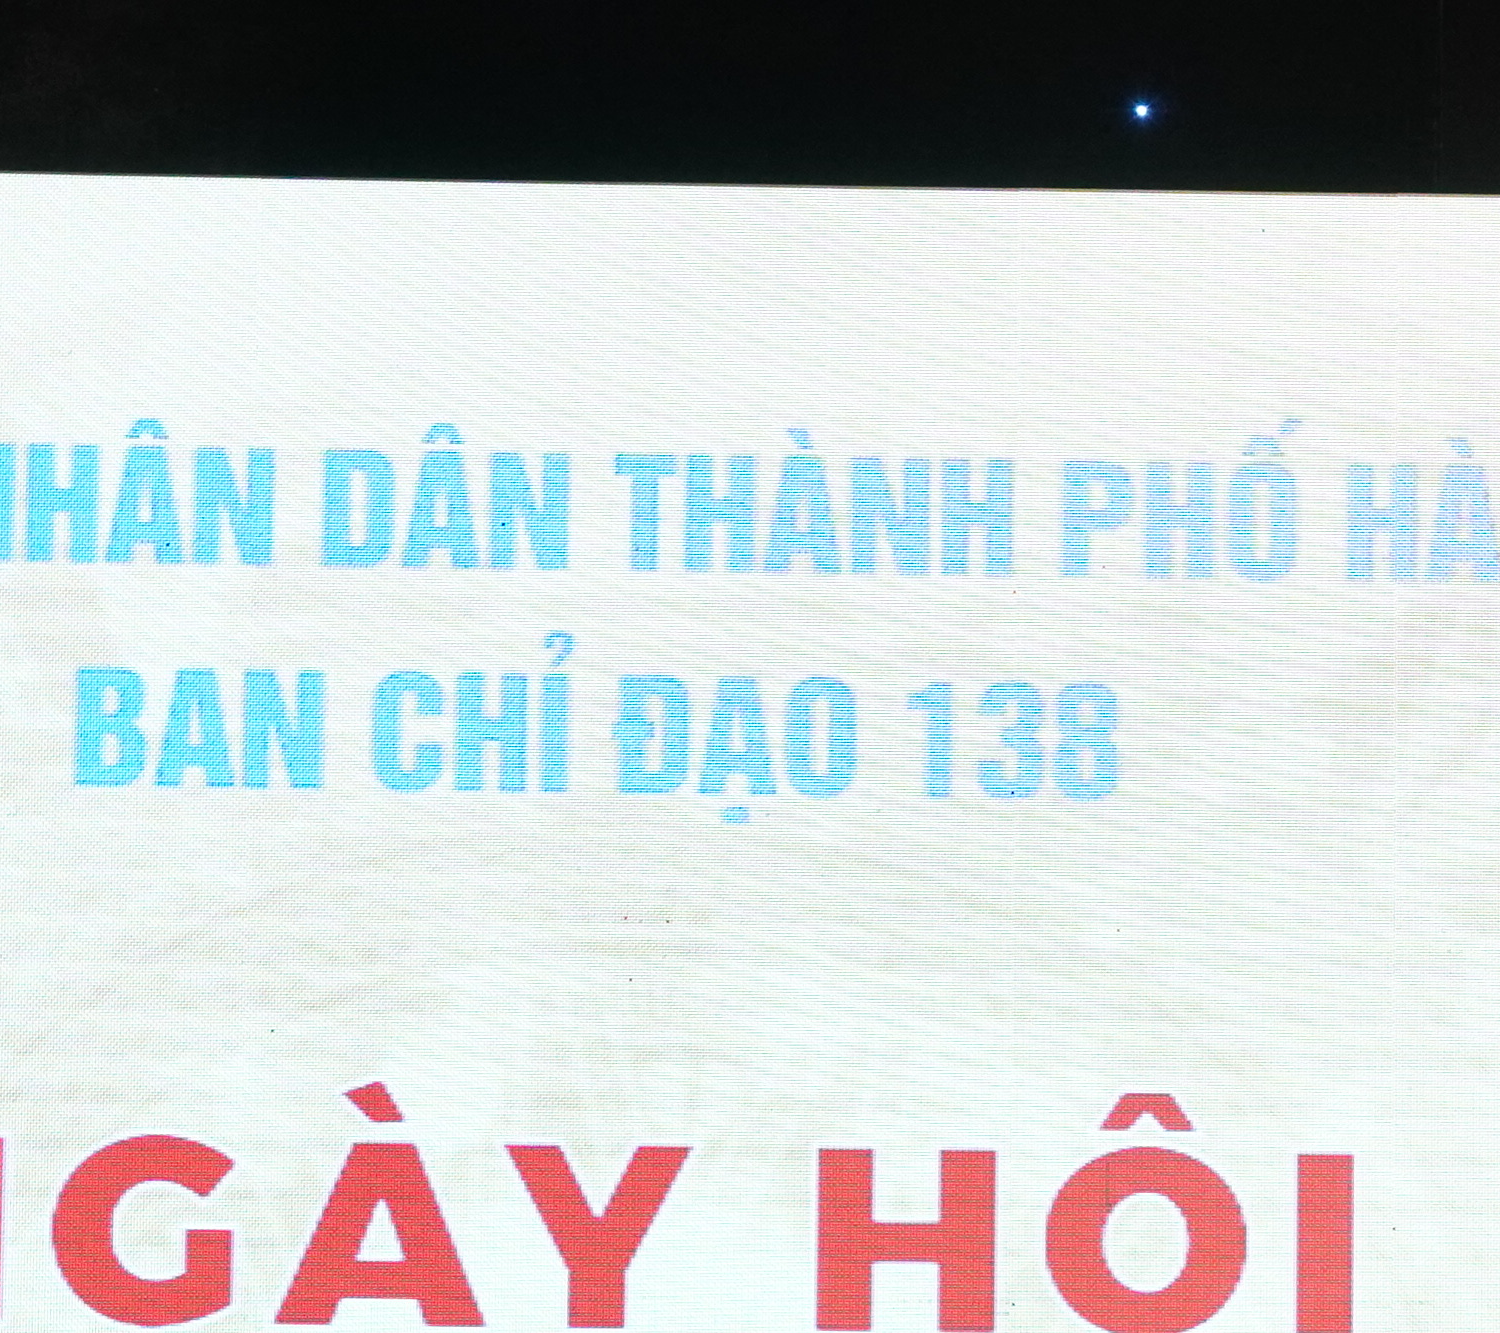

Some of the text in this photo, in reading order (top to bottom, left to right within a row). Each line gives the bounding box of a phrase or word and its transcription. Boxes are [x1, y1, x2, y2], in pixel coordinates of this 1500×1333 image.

[319, 421, 572, 572] DÂN
[612, 427, 1012, 578] THÀNH
[1060, 419, 1297, 583] PHỐ
[72, 629, 1120, 825] BAN CHỈ ĐẠO 138
